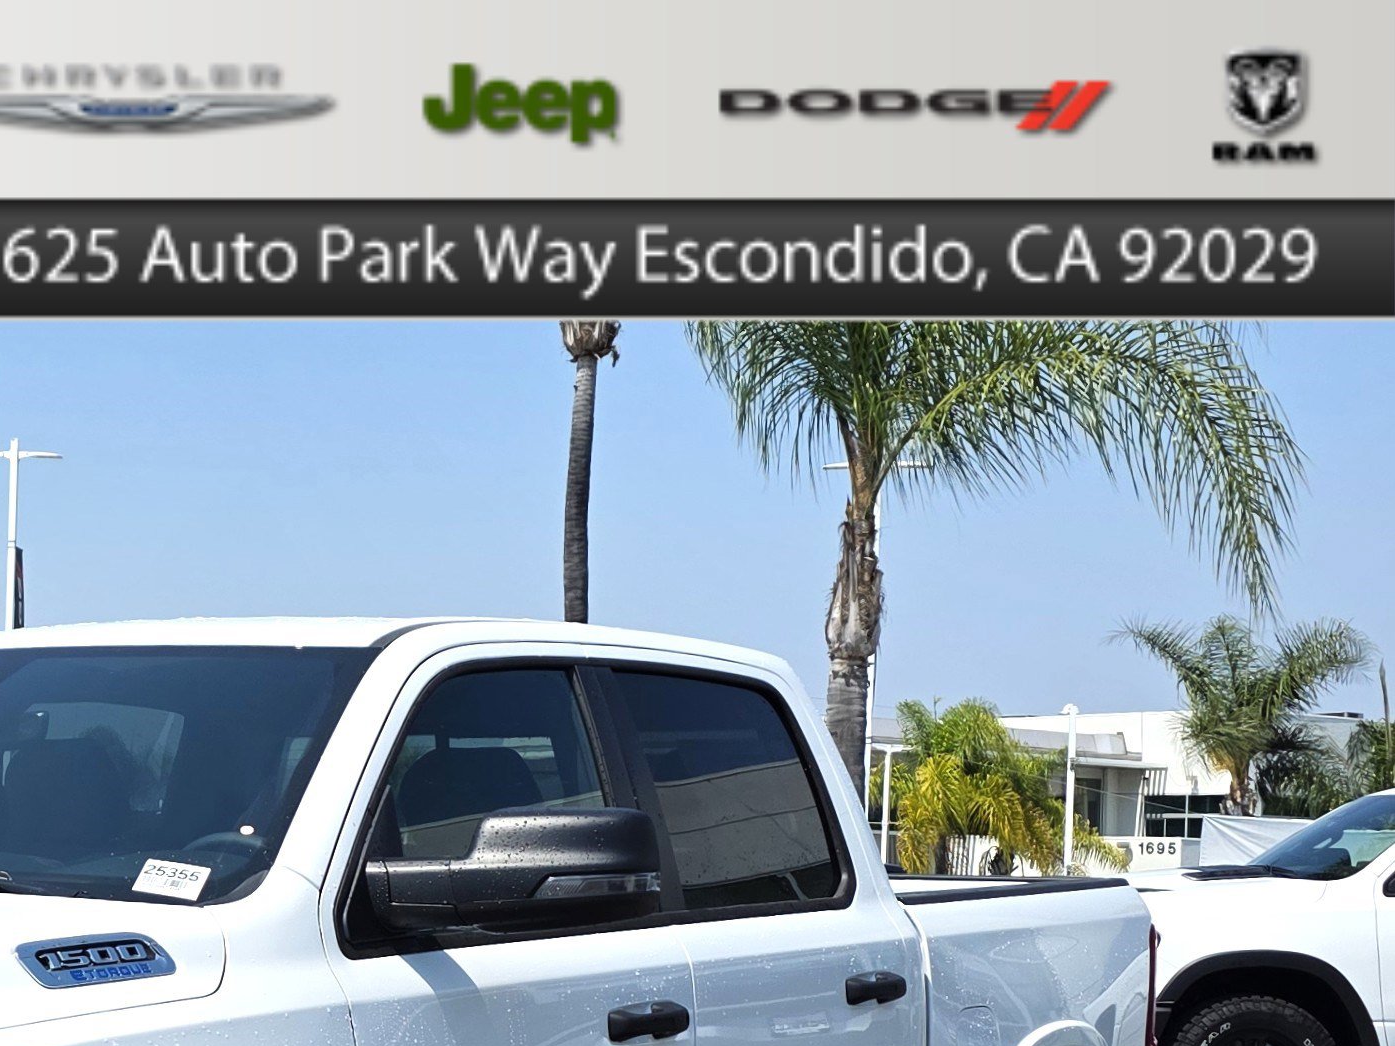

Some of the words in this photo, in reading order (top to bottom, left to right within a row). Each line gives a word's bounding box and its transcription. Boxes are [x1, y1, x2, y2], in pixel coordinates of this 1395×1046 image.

[1138, 841, 1177, 856] 1695
[143, 864, 202, 882] 25355
[38, 942, 149, 972] 1500
